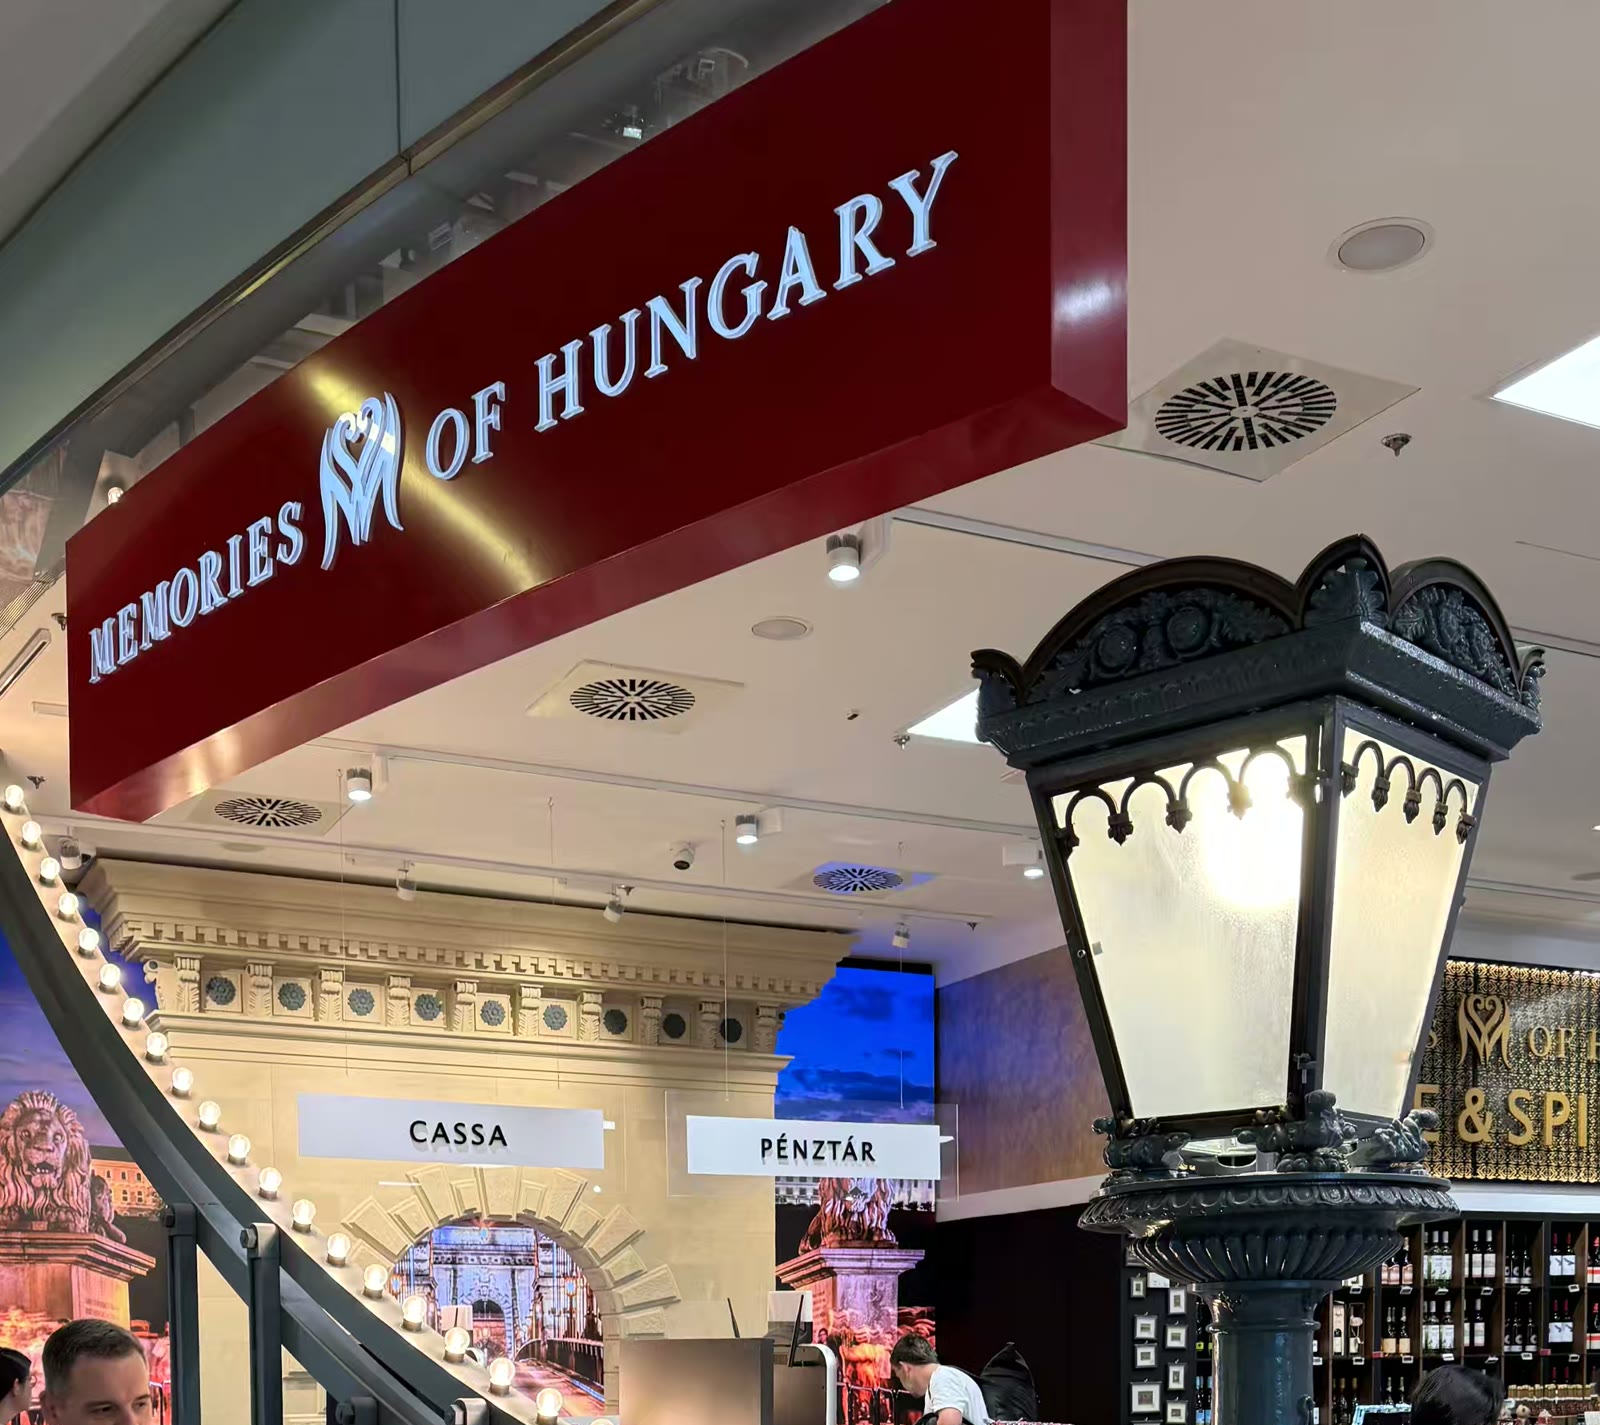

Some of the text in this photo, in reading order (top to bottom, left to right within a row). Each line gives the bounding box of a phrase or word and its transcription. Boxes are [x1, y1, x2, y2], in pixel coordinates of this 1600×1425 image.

[88, 500, 305, 685] MEMORIES
[424, 380, 506, 481] OF
[534, 149, 959, 433] HUNGARY
[1527, 1026, 1575, 1059] OF
[409, 1119, 508, 1147] CASSA
[1457, 1087, 1495, 1144] &
[1507, 1088, 1589, 1148] SPI
[760, 1132, 876, 1162] PÉNZTÁR
